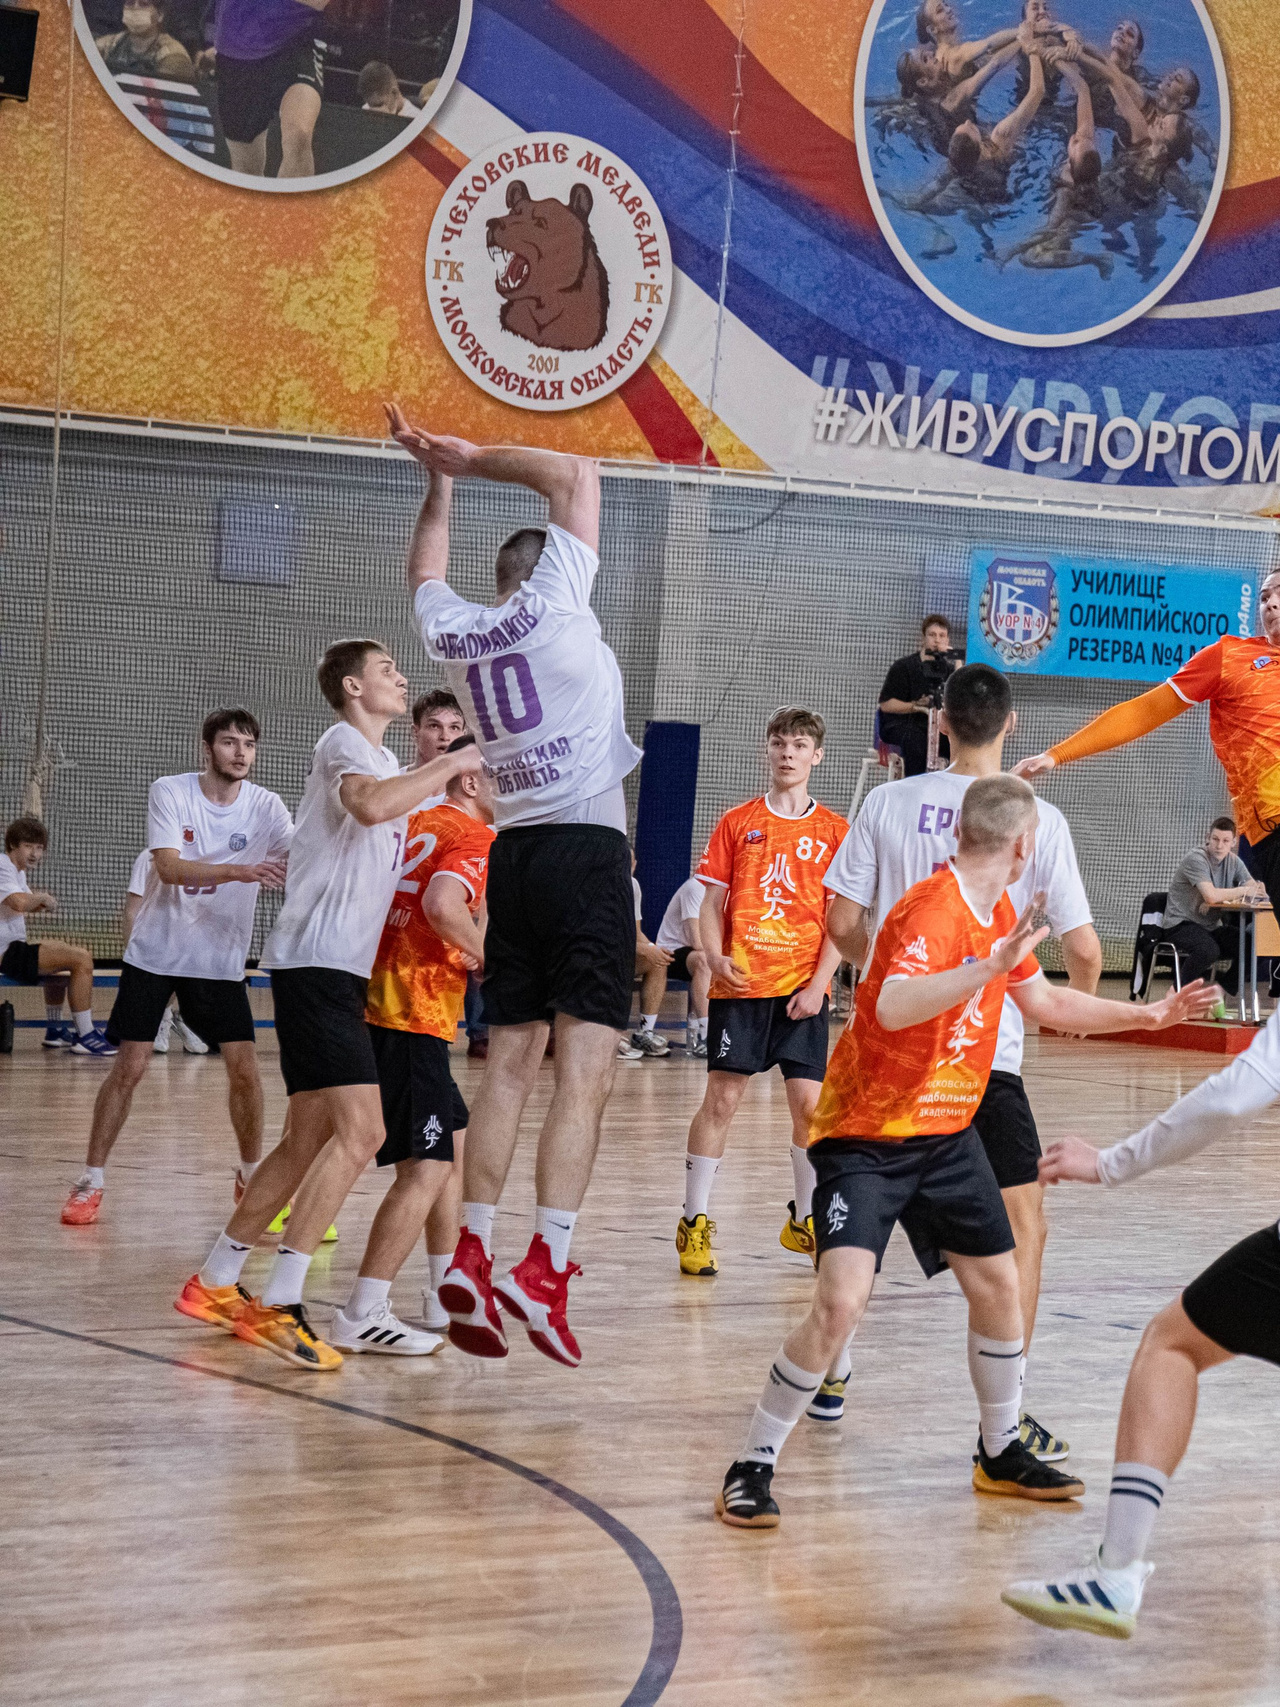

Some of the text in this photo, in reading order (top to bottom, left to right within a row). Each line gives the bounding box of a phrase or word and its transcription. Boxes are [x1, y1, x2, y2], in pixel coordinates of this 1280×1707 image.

[441, 142, 661, 270] ЧЕХОВСКИЕ МЕДВЕДИ
[432, 259, 464, 283] ГК
[634, 282, 663, 305] ГК
[440, 296, 653, 400] МОСКОВСКАЯ ОБЛАСТЬ
[527, 354, 560, 374] 2001
[1070, 569, 1166, 601] УЧИЛИЩЕ
[1069, 603, 1230, 637] ОЛИМПИЙСКОГО
[1067, 637, 1146, 666] РЕЗЕРВА
[465, 653, 544, 743] 10
[497, 764, 560, 795] ОБЛАСТЬ
[918, 803, 961, 838] ЕР
[796, 836, 829, 864] 87
[917, 1091, 978, 1104] андбольная
[926, 1079, 978, 1089] осковская
[919, 1107, 967, 1118] академия
